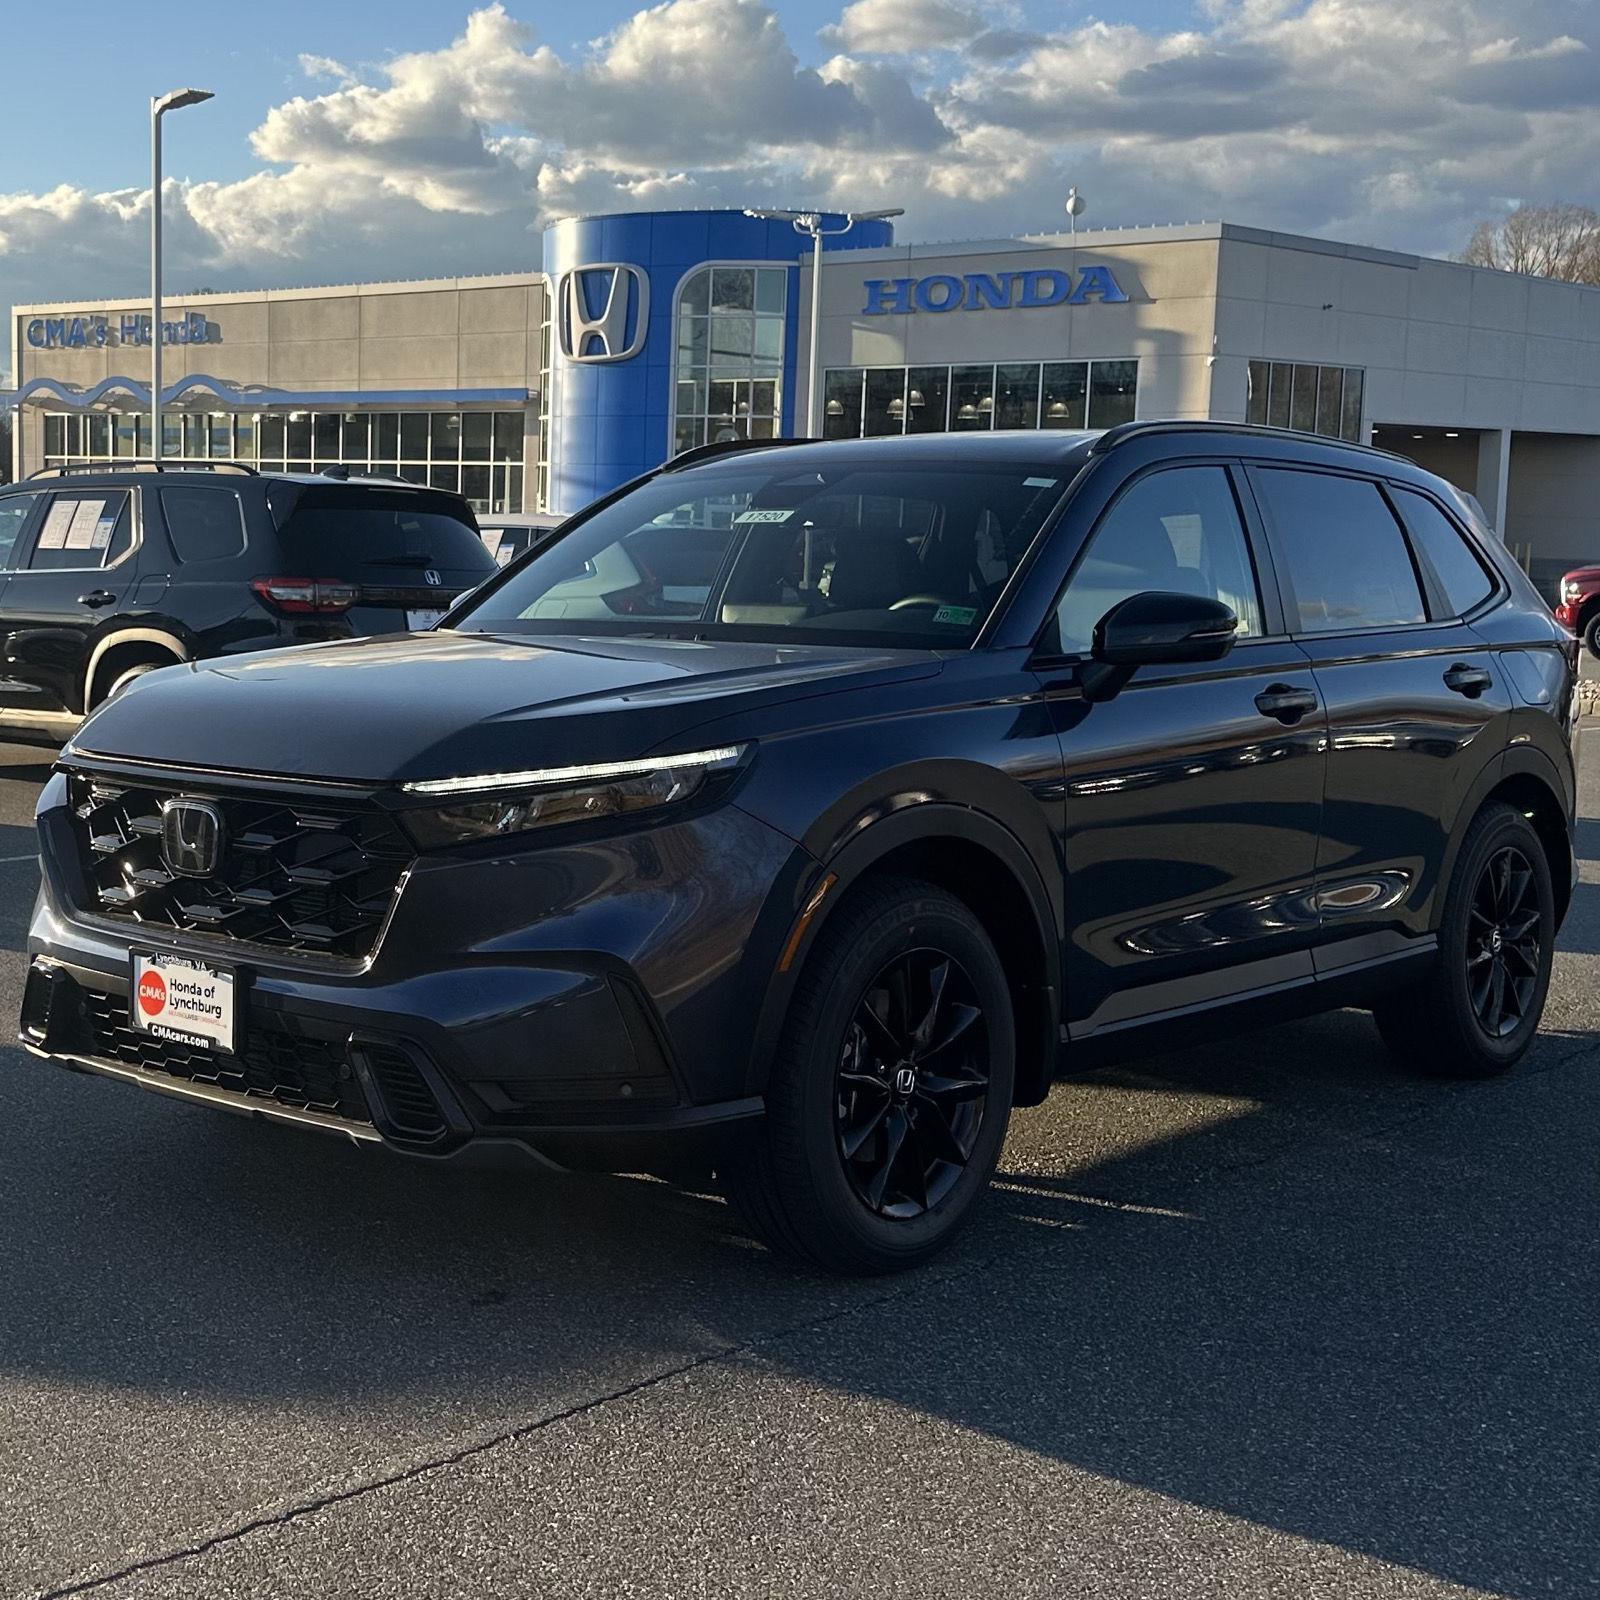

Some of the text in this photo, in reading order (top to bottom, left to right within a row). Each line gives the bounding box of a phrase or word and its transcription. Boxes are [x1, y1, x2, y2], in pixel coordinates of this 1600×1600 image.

[862, 265, 1130, 315] HONDA
[27, 311, 209, 347] CMA's Honda
[139, 984, 166, 1001] CMA's
[169, 978, 216, 998] Honda of
[169, 993, 222, 1019] Lynchburg
[151, 1024, 209, 1049] CMAcars.com
